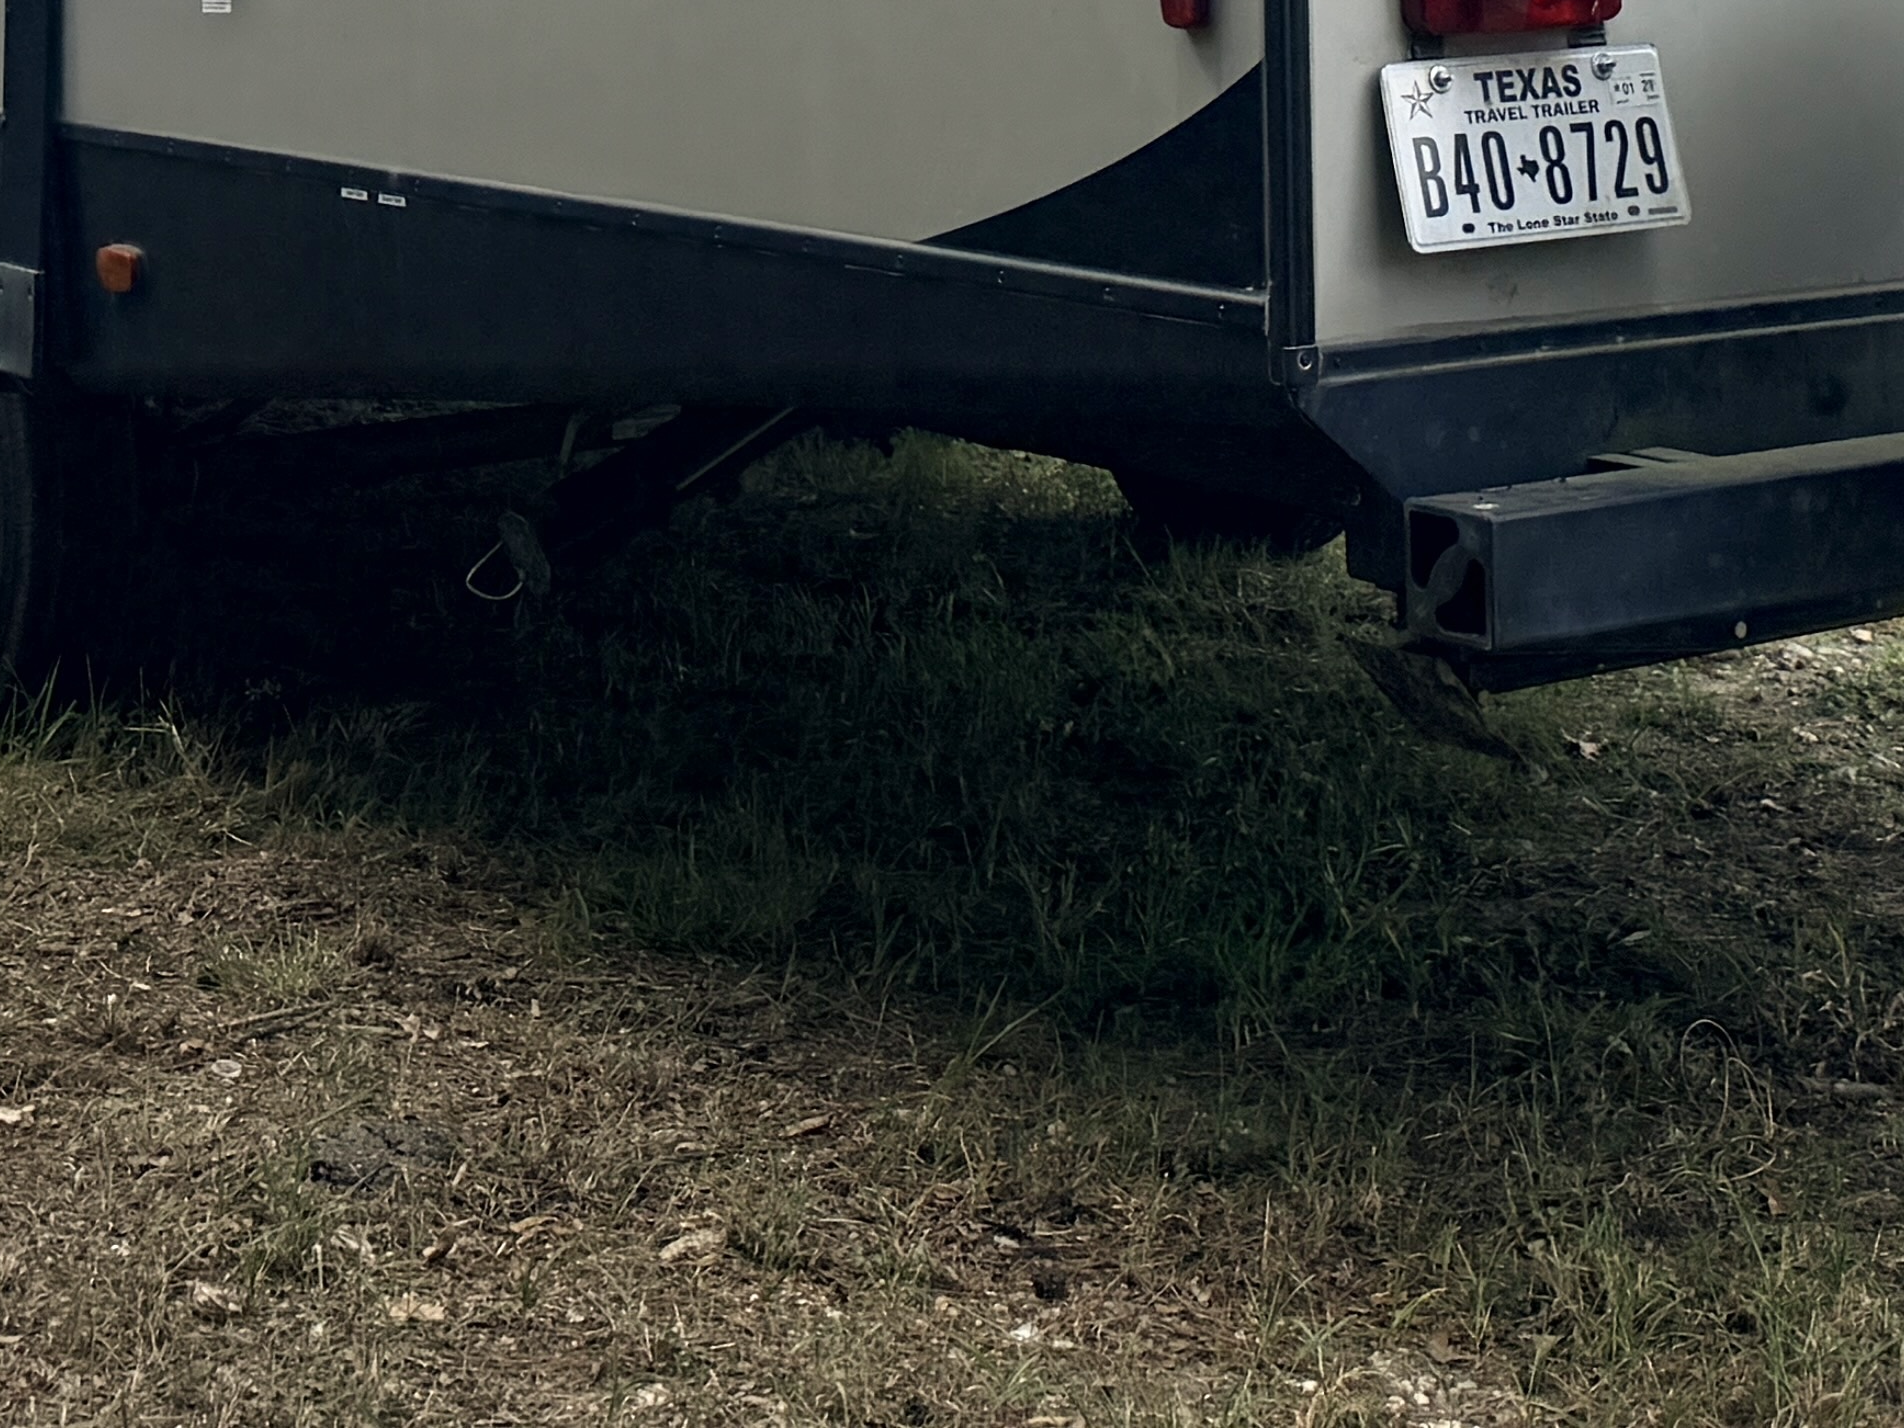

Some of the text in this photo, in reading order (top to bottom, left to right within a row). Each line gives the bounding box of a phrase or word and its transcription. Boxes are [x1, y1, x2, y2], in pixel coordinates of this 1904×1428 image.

[1473, 64, 1582, 105] TEXAS
[1464, 99, 1600, 124] TRAVEL TRAILER
[1487, 210, 1618, 234] The Lone Star State
